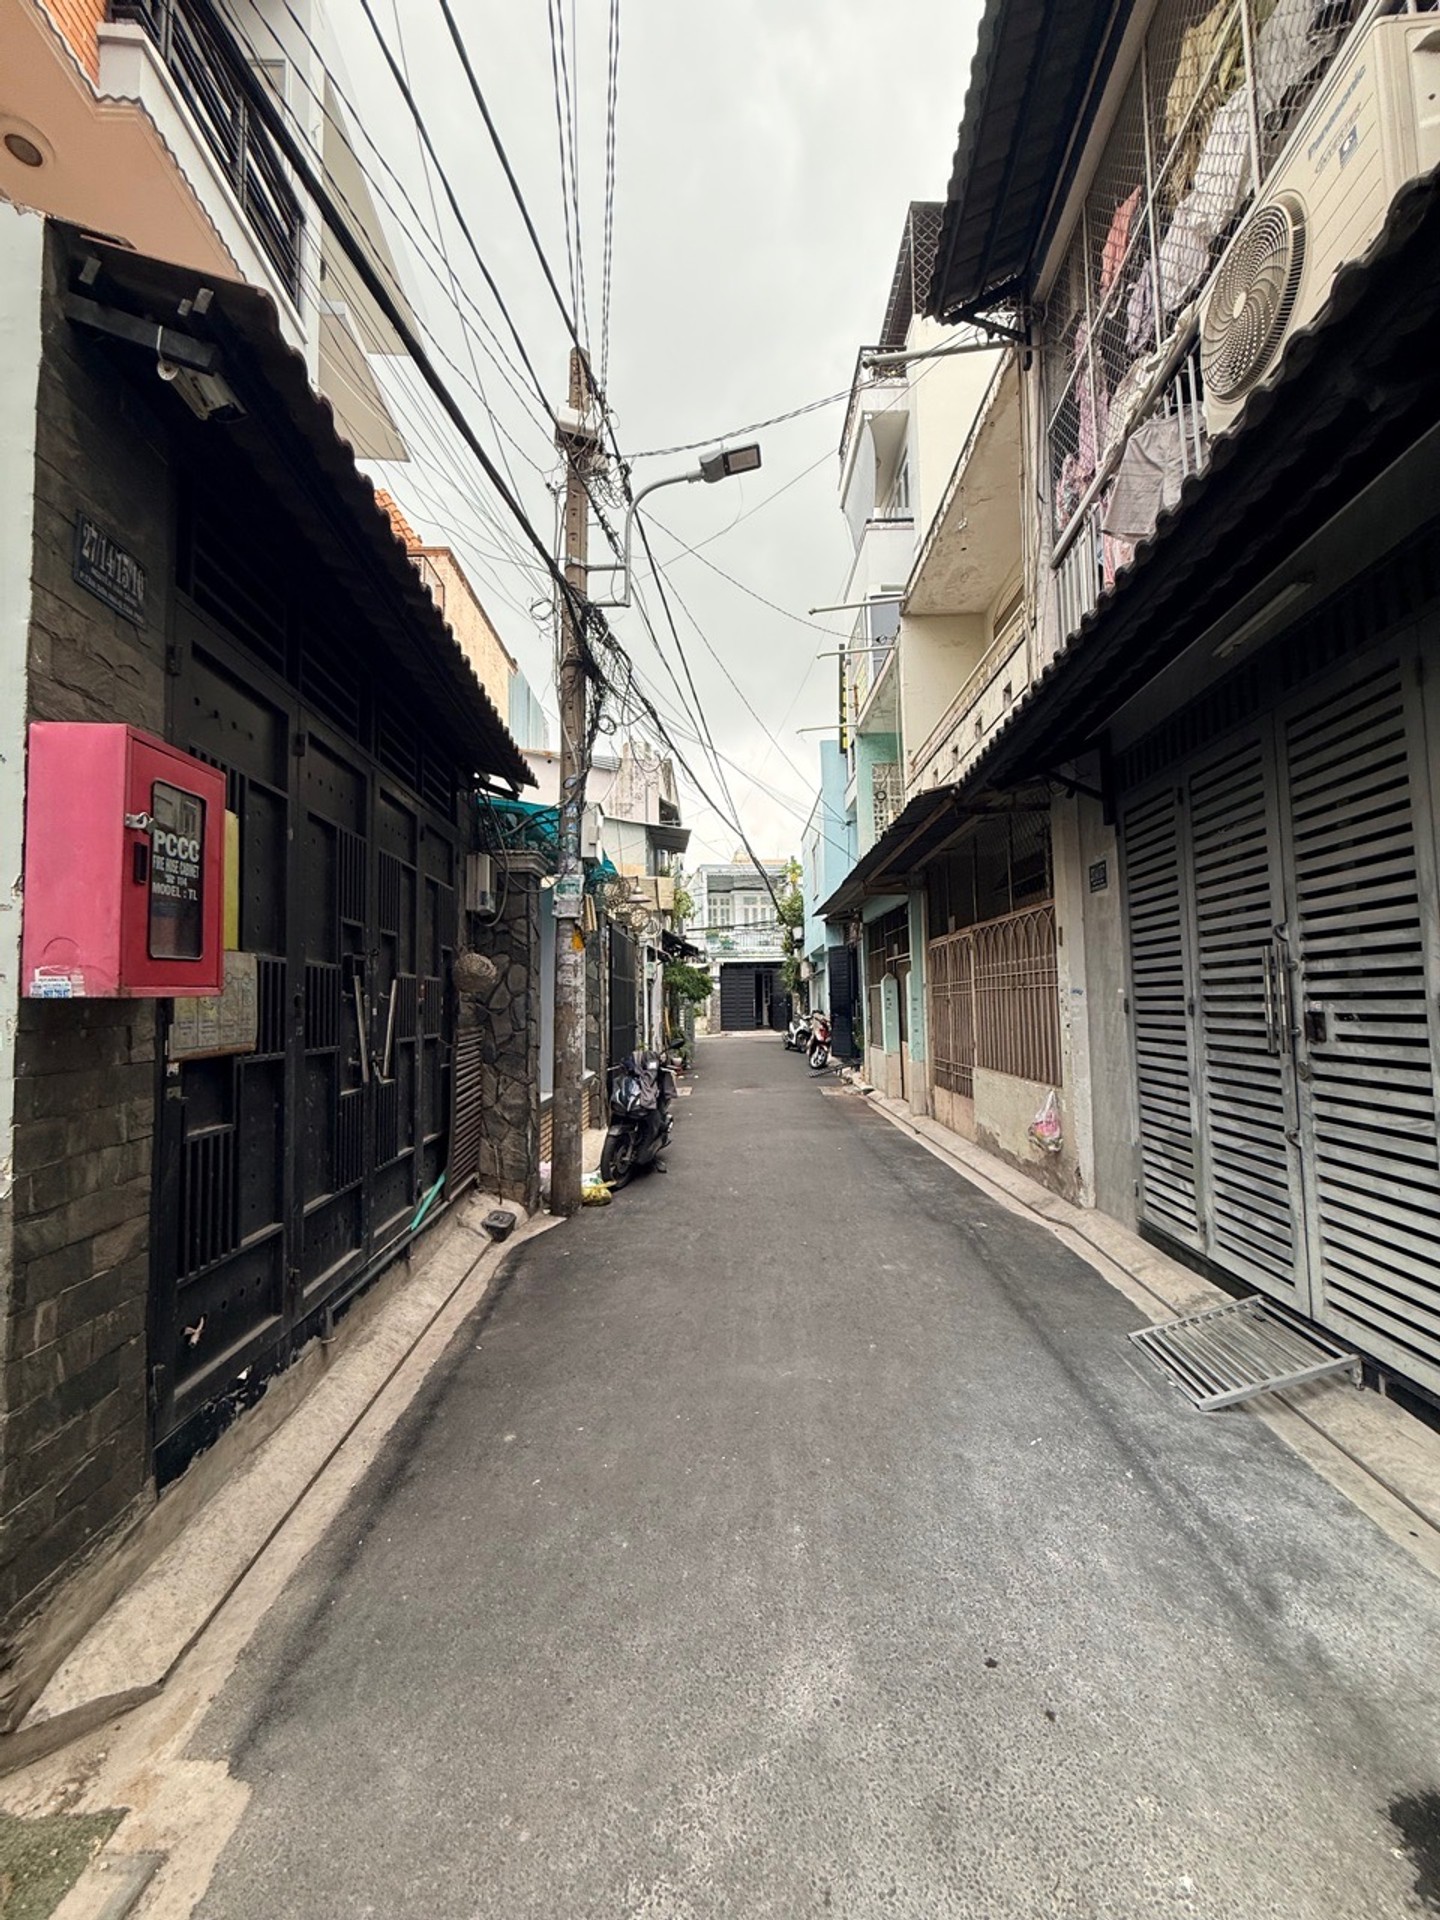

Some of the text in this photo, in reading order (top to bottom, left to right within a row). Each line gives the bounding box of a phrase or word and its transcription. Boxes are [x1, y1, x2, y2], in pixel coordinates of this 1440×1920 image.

[1308, 64, 1366, 161] Panasonic
[153, 829, 200, 863] PCCC
[152, 855, 199, 878] FIRE HOSE CABINET
[152, 882, 181, 898] MODEL
[187, 888, 198, 901] TL
